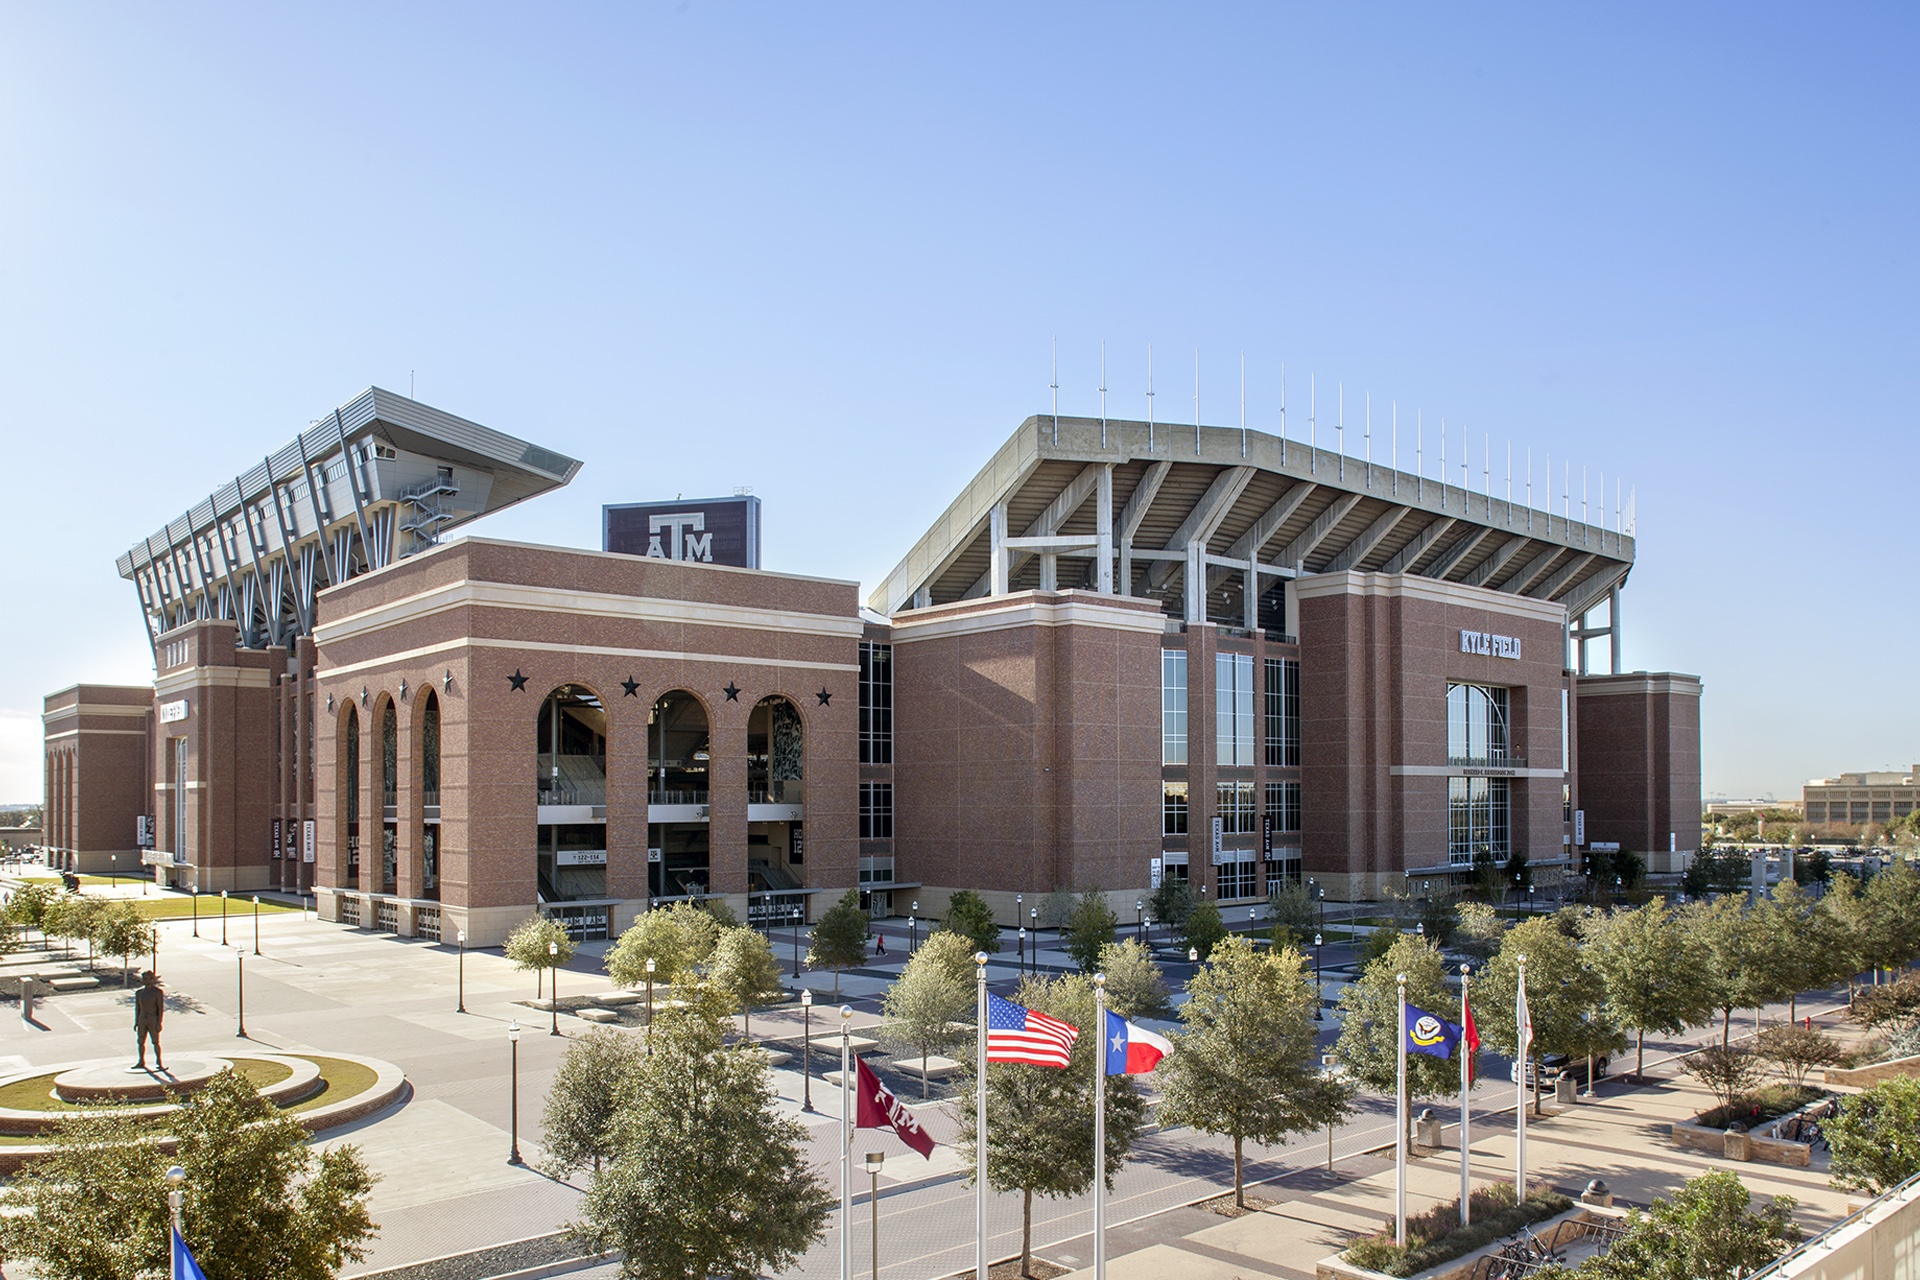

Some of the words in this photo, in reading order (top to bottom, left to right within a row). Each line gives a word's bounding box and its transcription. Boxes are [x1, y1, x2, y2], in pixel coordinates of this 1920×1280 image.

[1460, 629, 1491, 656] KYLE
[1492, 634, 1521, 660] FIELD
[793, 840, 802, 854] 12
